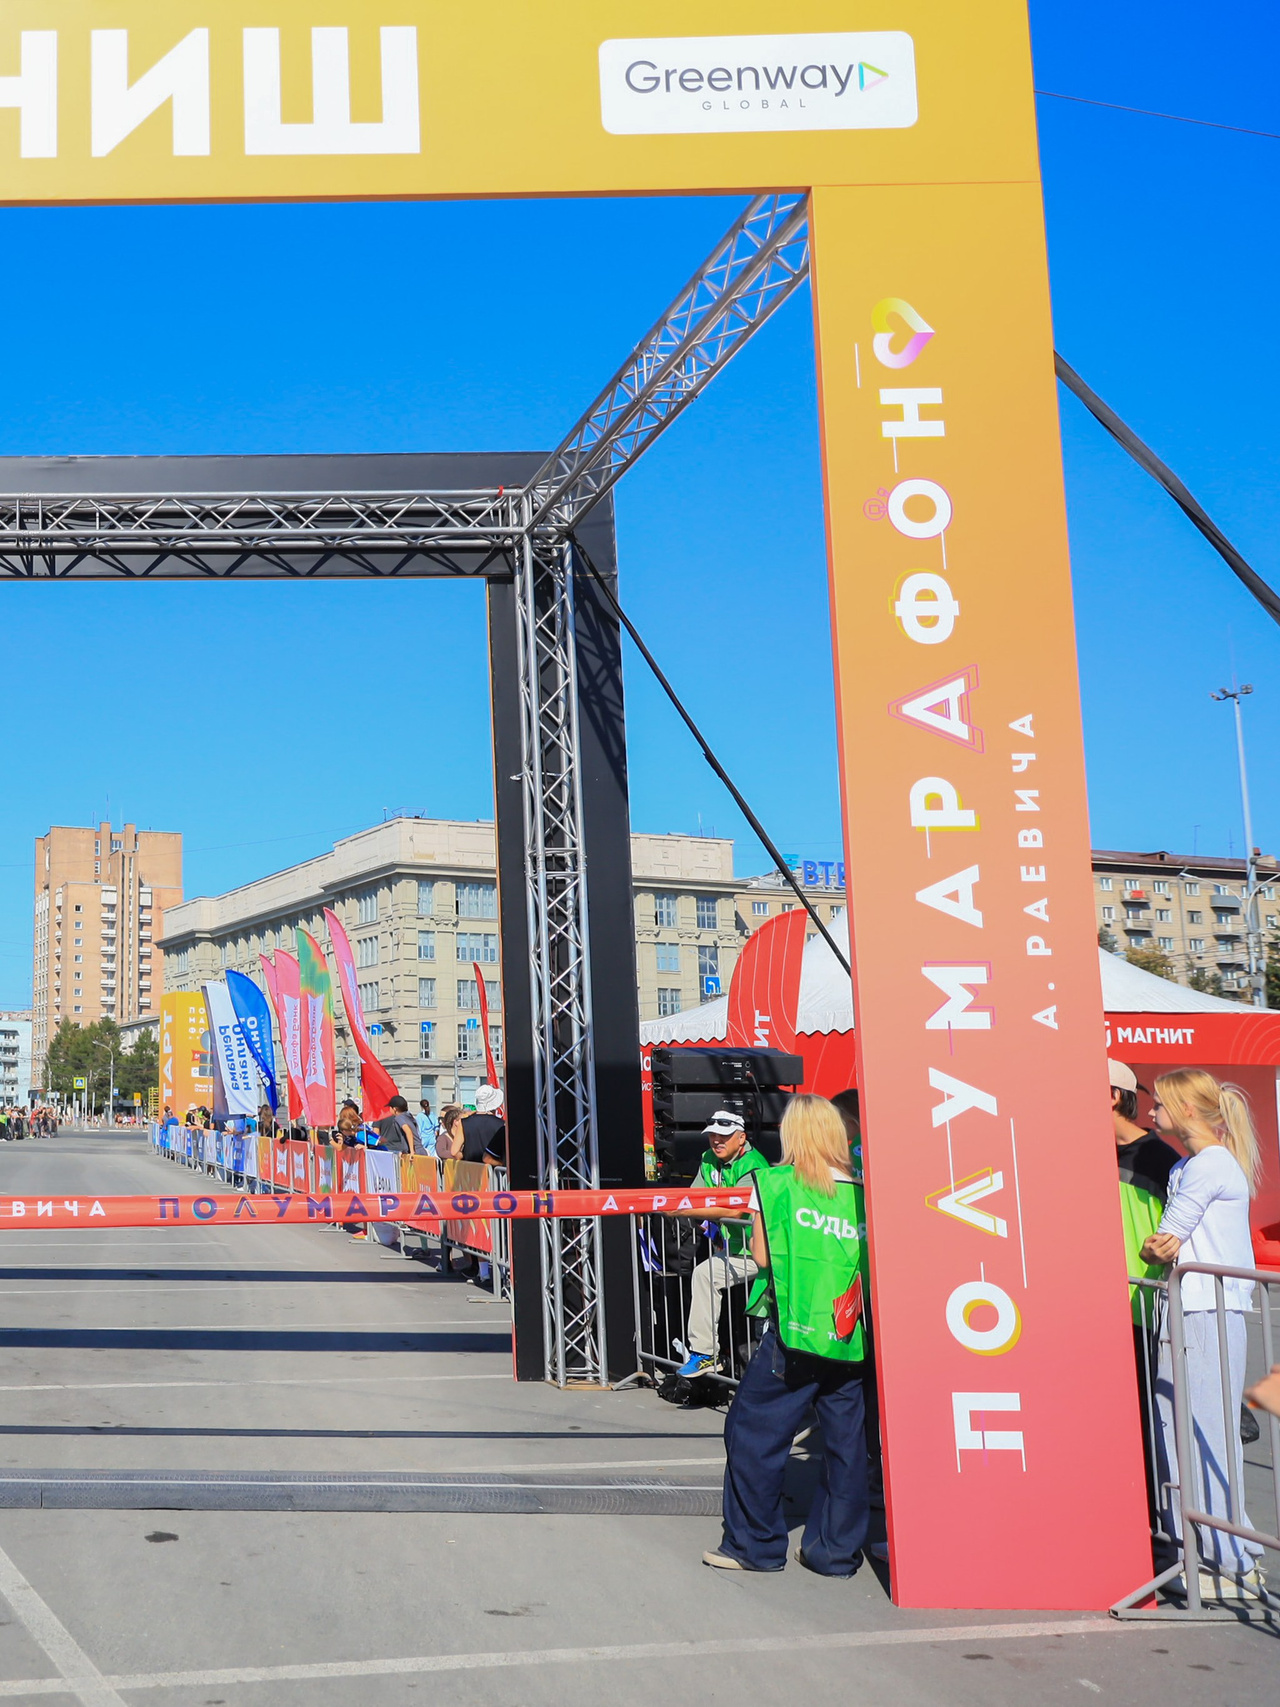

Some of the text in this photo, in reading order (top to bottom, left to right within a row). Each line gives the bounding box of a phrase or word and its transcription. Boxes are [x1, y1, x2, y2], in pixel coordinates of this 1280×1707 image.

[624, 60, 855, 98] Greenway
[701, 98, 807, 111] GLOBAL
[1008, 713, 1059, 1030] А. РАЕВИЧА
[878, 387, 1025, 1452] ПОЛУМАРАФОН
[1117, 1027, 1195, 1045] МАГНИТ
[163, 1009, 173, 1103] ТАРТ
[157, 1191, 555, 1219] ПОЛУМАРАФОН
[601, 1194, 635, 1211] А.
